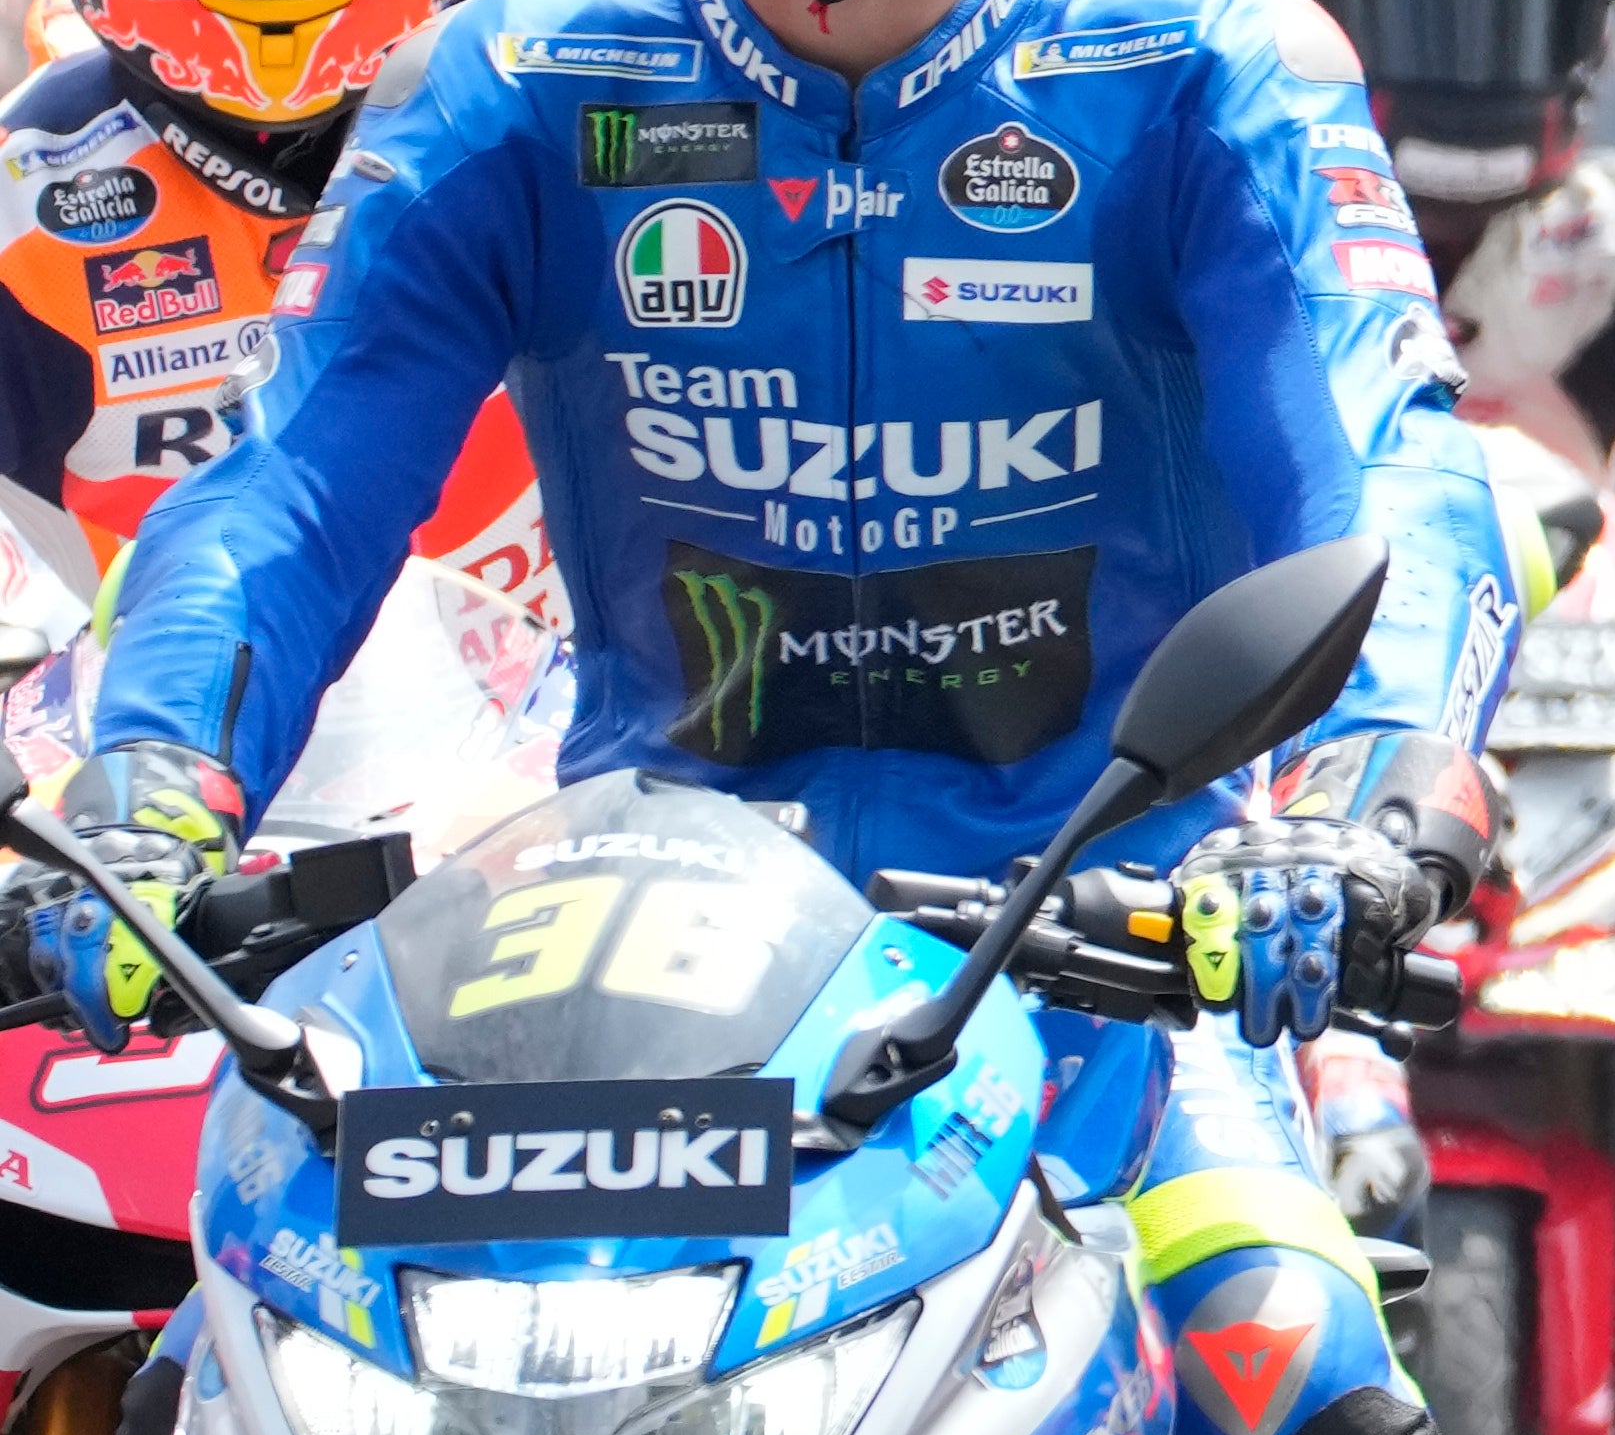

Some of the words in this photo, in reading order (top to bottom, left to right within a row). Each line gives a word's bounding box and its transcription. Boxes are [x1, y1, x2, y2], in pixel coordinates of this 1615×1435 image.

[555, 44, 680, 70] MICHELIN
[1069, 28, 1186, 62] MICHELIN
[638, 121, 750, 143] MONSTER
[53, 175, 135, 207] Estrella
[161, 124, 288, 213] REPSOL
[963, 153, 1057, 183] Estrella
[59, 196, 137, 224] Galicia
[963, 178, 1051, 209] Galicia
[98, 297, 156, 330] Red
[159, 281, 220, 318] Bull
[639, 279, 728, 324] agv
[956, 281, 1078, 306] SUZUKI
[111, 338, 230, 384] Allianz
[604, 352, 798, 411] Team
[625, 399, 1104, 498] SUZUKI
[763, 500, 959, 556] MotoGP
[778, 597, 1069, 666] MONSTER
[830, 658, 1033, 690] ENERGY
[449, 876, 778, 1019] 36
[364, 1128, 769, 1198] SUZUKI
[270, 1228, 382, 1307] SUZUKI
[755, 1224, 898, 1306] SUZUKI
